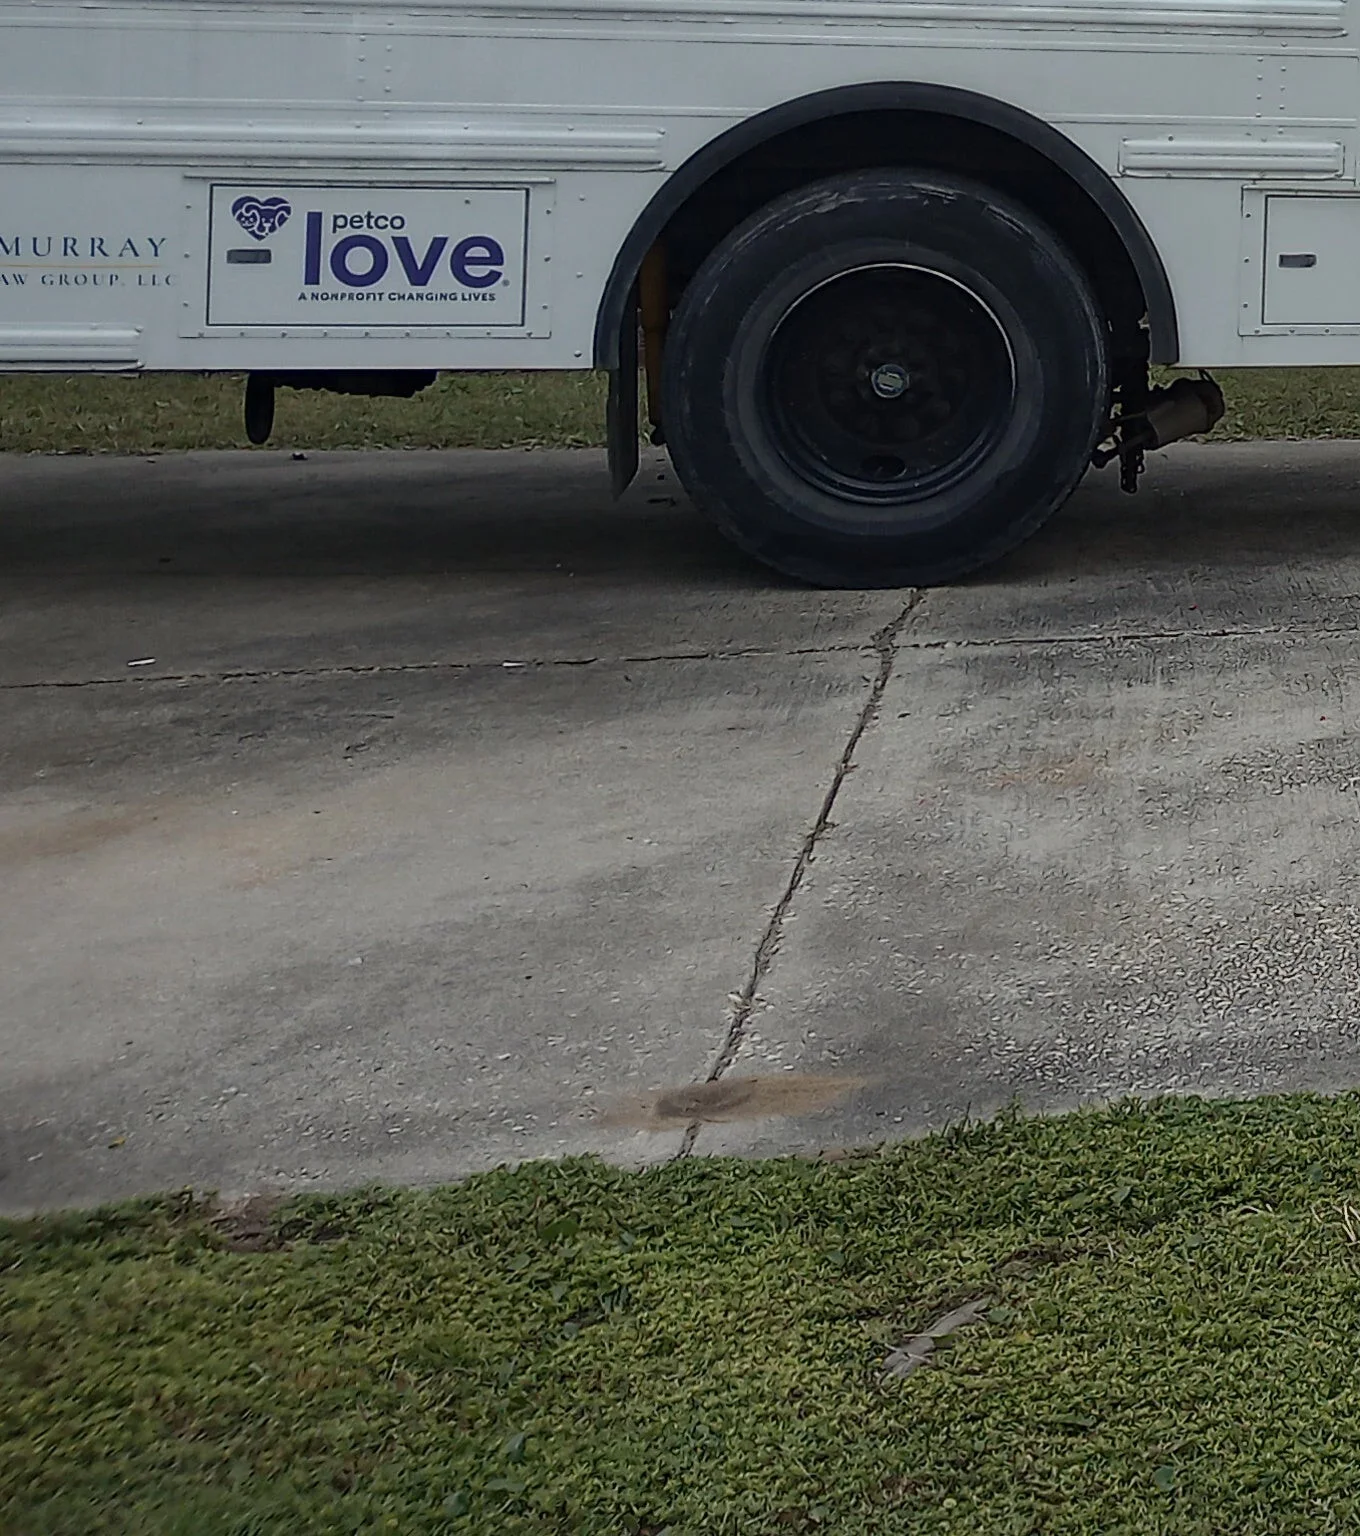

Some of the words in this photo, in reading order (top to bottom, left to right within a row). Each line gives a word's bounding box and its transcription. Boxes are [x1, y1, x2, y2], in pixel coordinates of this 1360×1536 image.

[332, 211, 405, 233] petco
[0, 236, 167, 258] MURRAY
[304, 212, 505, 288] love
[138, 274, 178, 287] LLC
[298, 292, 307, 301] A
[311, 292, 384, 301] NONPROFIT
[388, 292, 458, 302] CHANGING
[461, 292, 496, 302] LIVES
